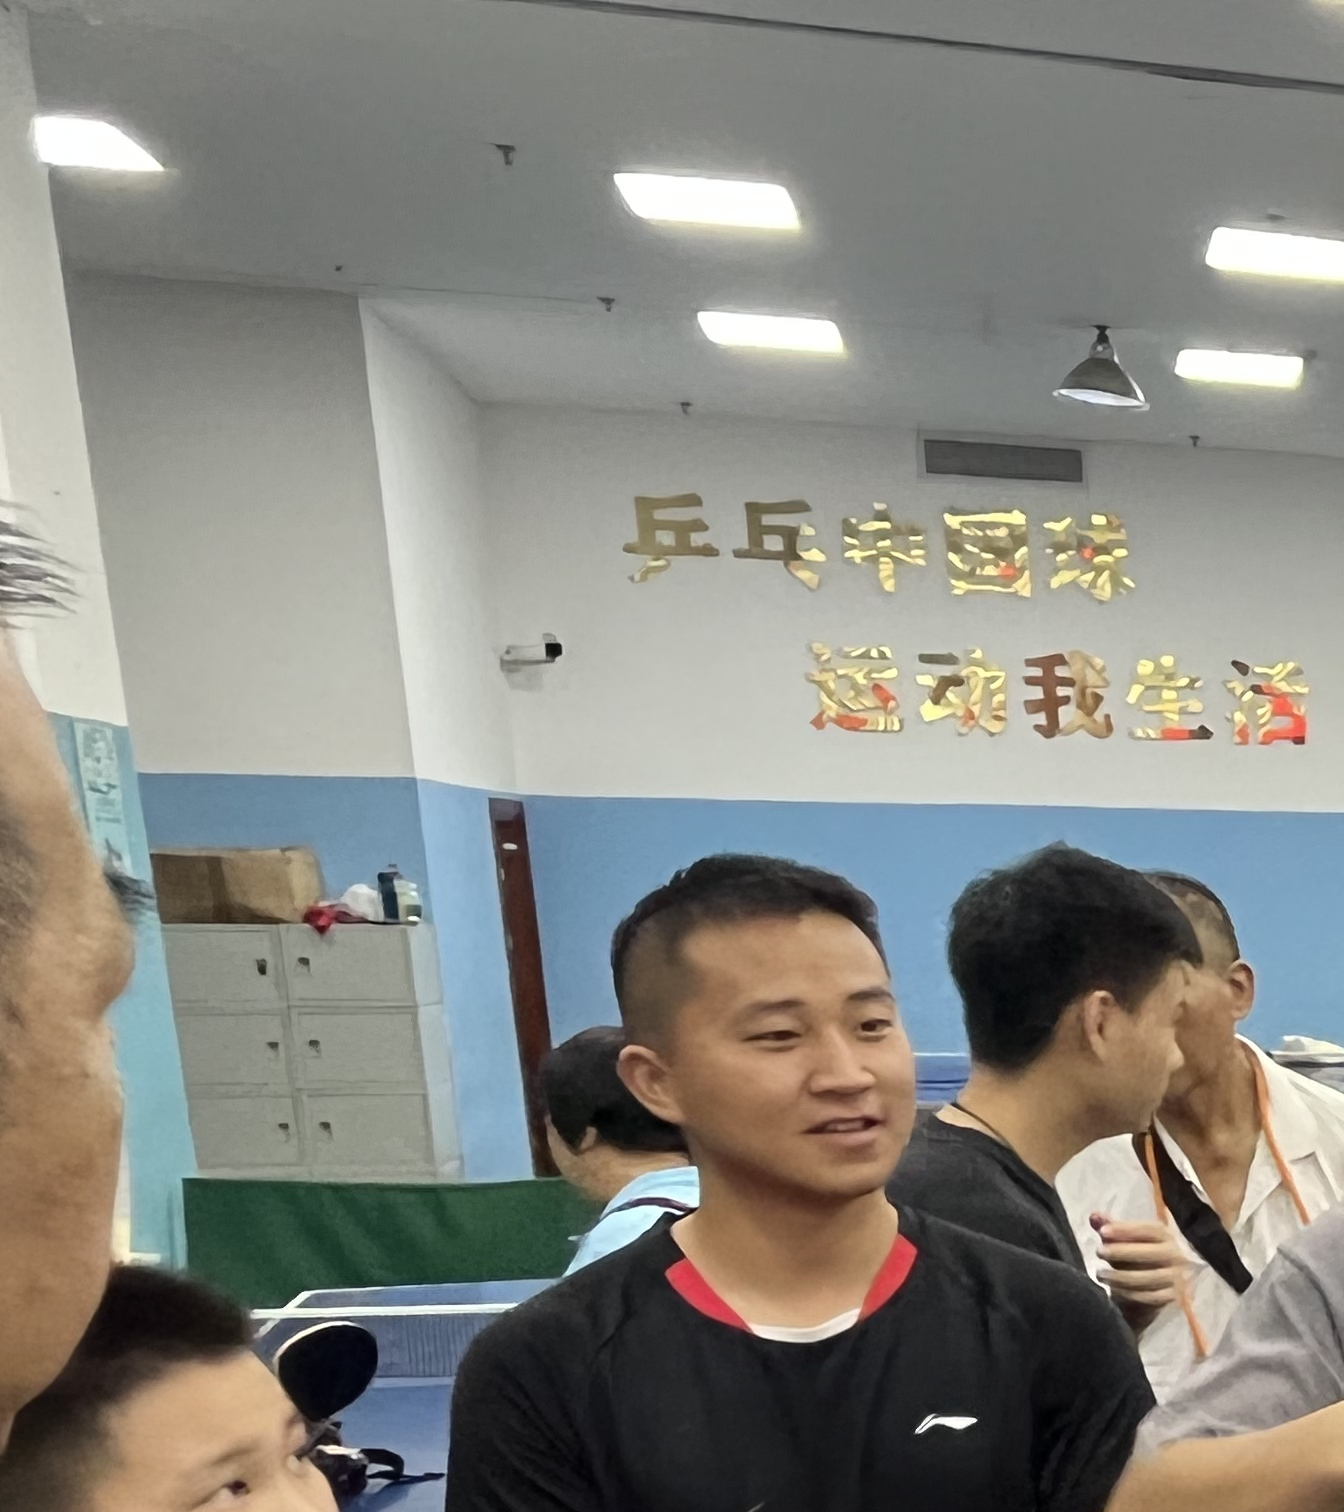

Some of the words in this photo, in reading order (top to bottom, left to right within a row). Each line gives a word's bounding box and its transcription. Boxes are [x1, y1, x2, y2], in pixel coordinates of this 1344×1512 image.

[805, 640, 1312, 746] 运动我生活
